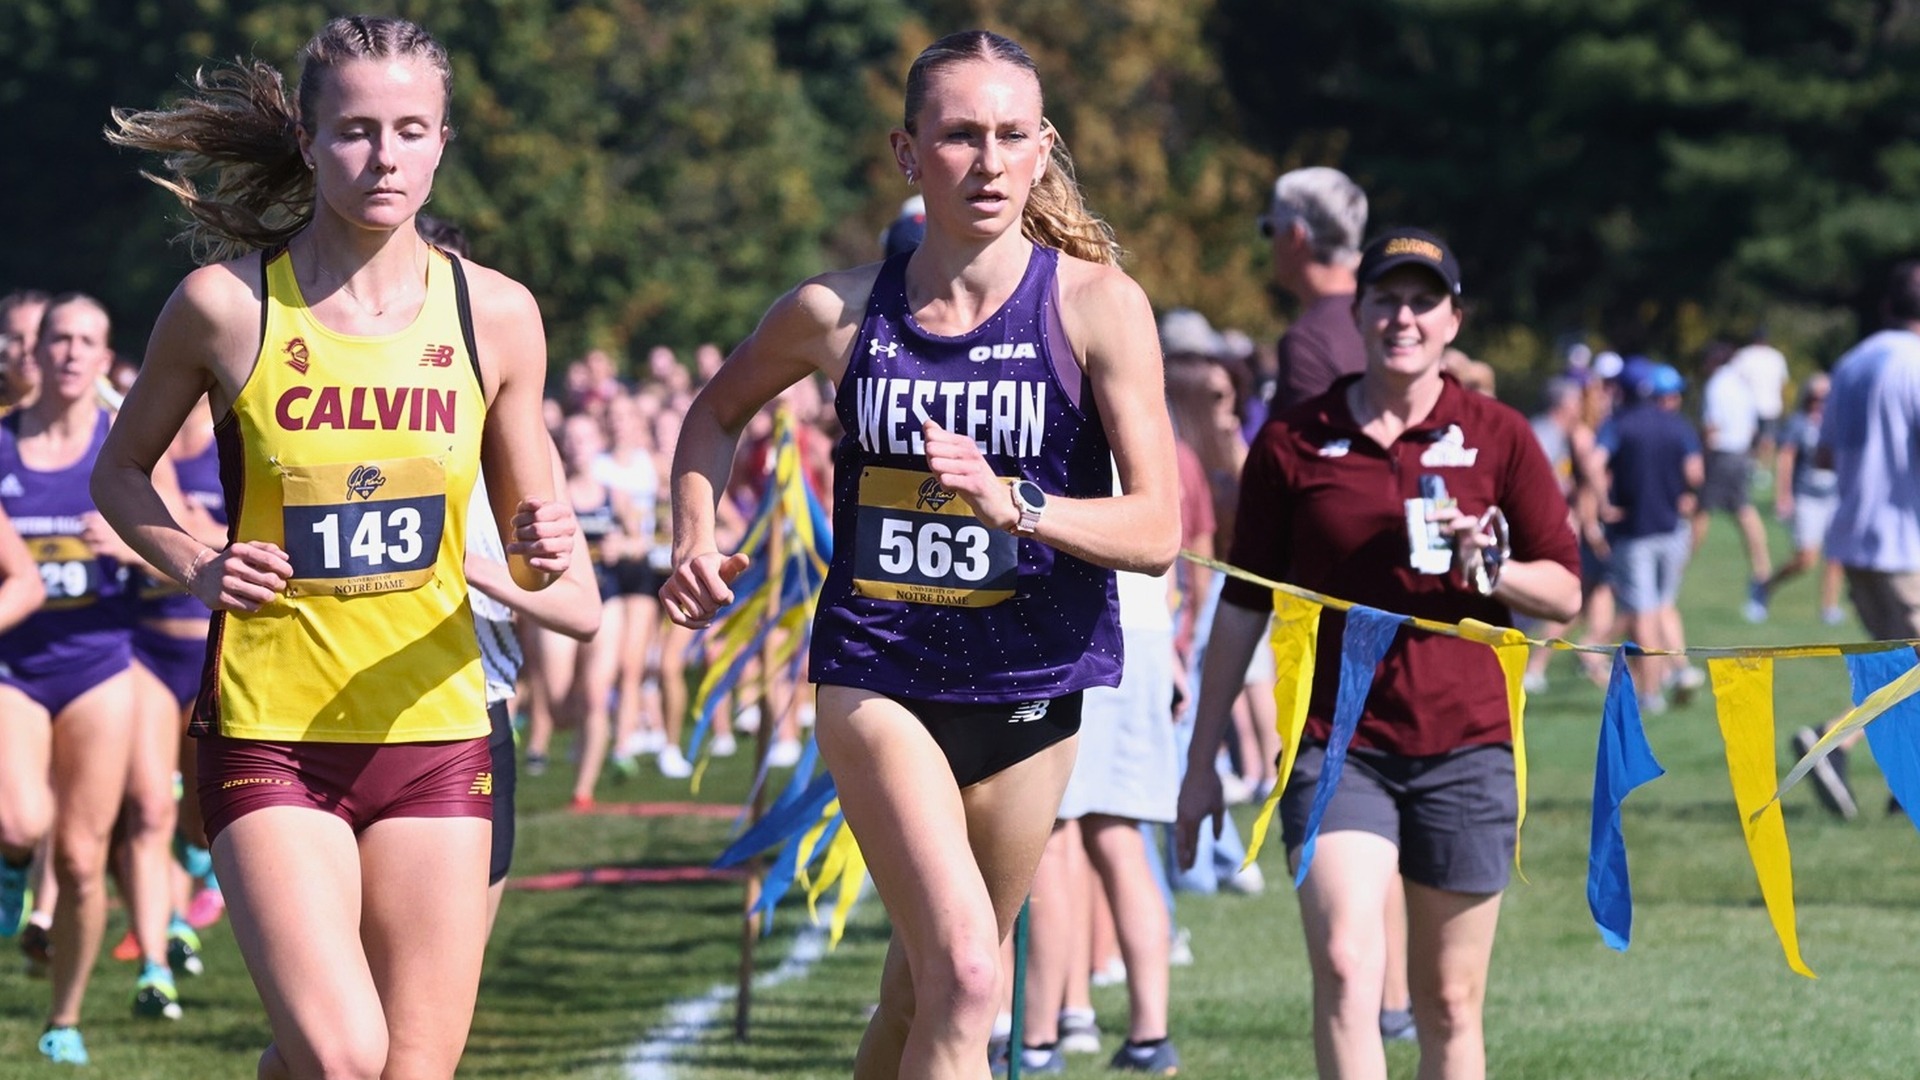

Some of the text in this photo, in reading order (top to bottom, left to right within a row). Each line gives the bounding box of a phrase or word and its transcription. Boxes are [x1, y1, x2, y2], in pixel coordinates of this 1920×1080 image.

[968, 342, 1037, 362] OUA
[275, 385, 457, 434] CALVIN
[856, 377, 1047, 459] WESTERN
[312, 507, 423, 569] 143
[878, 518, 990, 582] 563
[40, 561, 88, 597] 29
[333, 579, 405, 595] NOTRE DAME
[347, 576, 382, 584] UNIVERSITY
[909, 585, 946, 594] UNIVERSITY
[896, 590, 969, 605] NOTRE DAME
